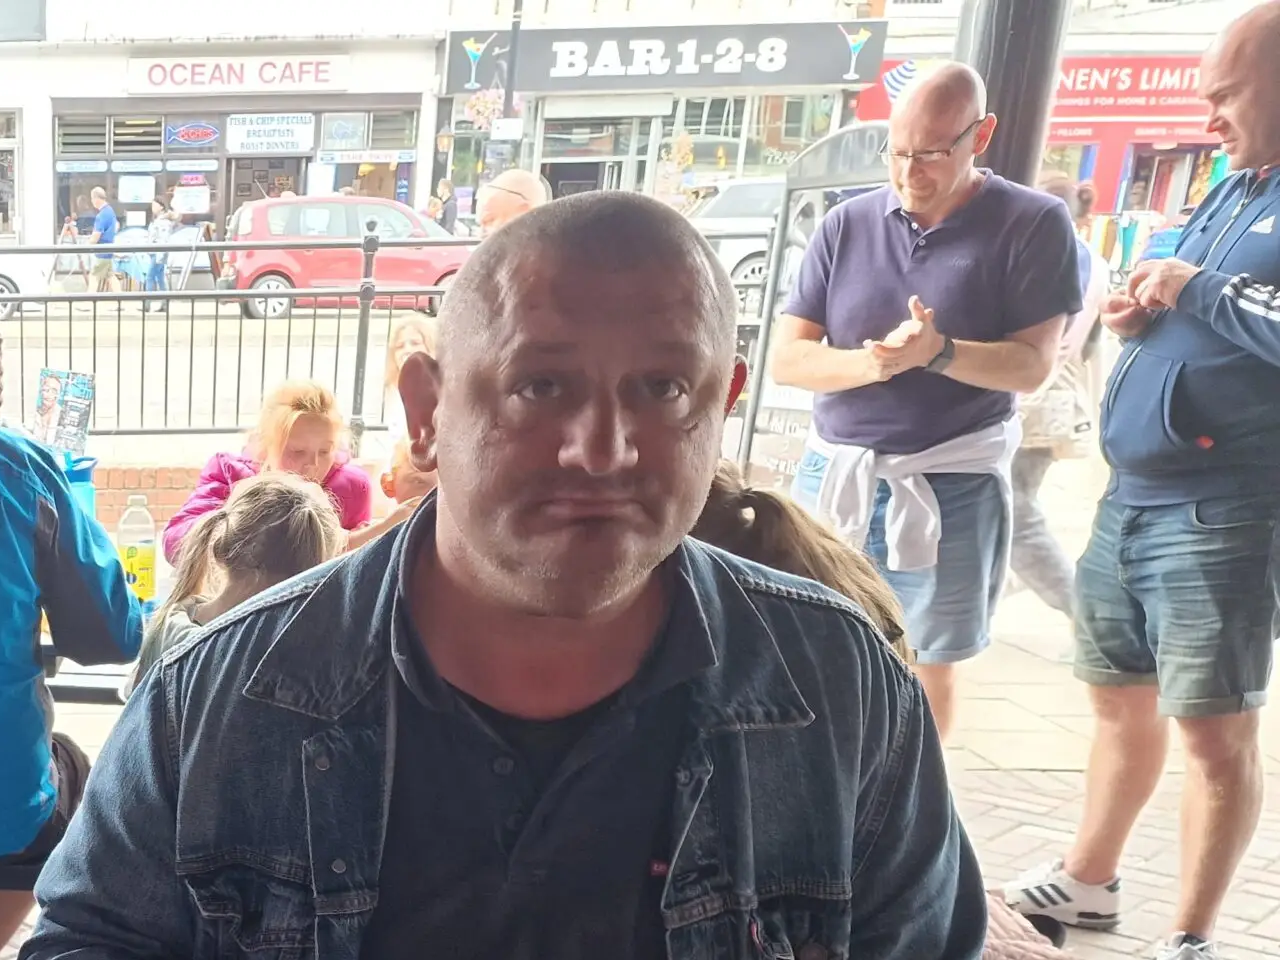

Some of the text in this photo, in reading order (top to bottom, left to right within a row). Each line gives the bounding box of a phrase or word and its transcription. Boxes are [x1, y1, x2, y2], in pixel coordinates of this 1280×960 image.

[549, 38, 788, 78] BAR 1-2-8
[147, 60, 332, 86] OCEAN CAFE
[1138, 67, 1202, 91] LIMIT
